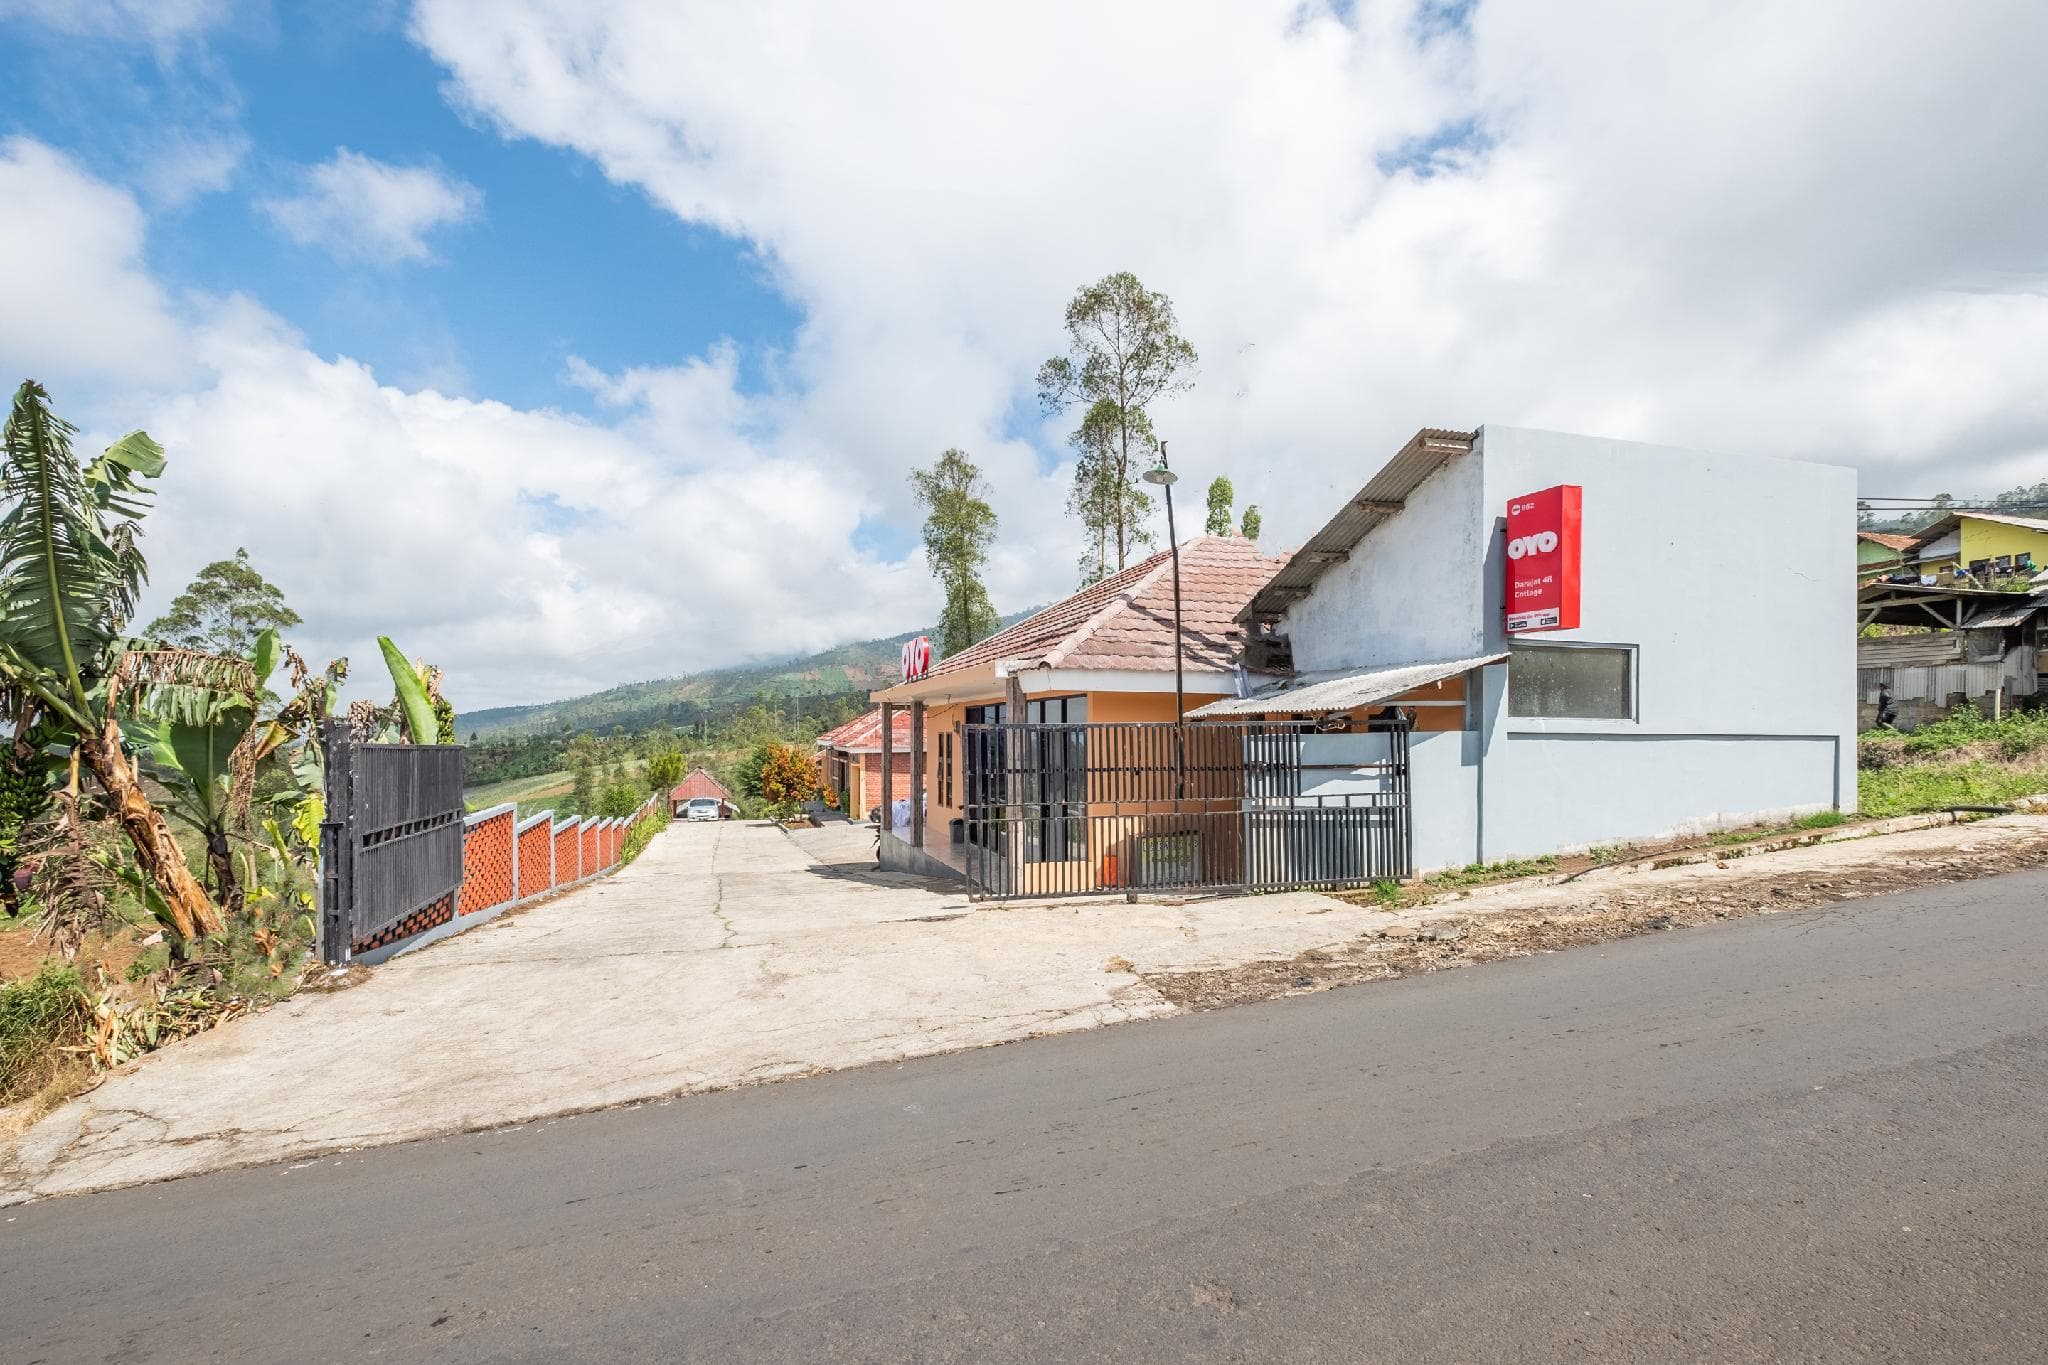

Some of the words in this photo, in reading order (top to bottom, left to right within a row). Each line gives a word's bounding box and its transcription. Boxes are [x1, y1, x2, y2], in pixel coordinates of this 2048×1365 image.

[1507, 531, 1558, 559] OYO
[1514, 588, 1543, 599] Cottage
[901, 636, 926, 680] OYO
